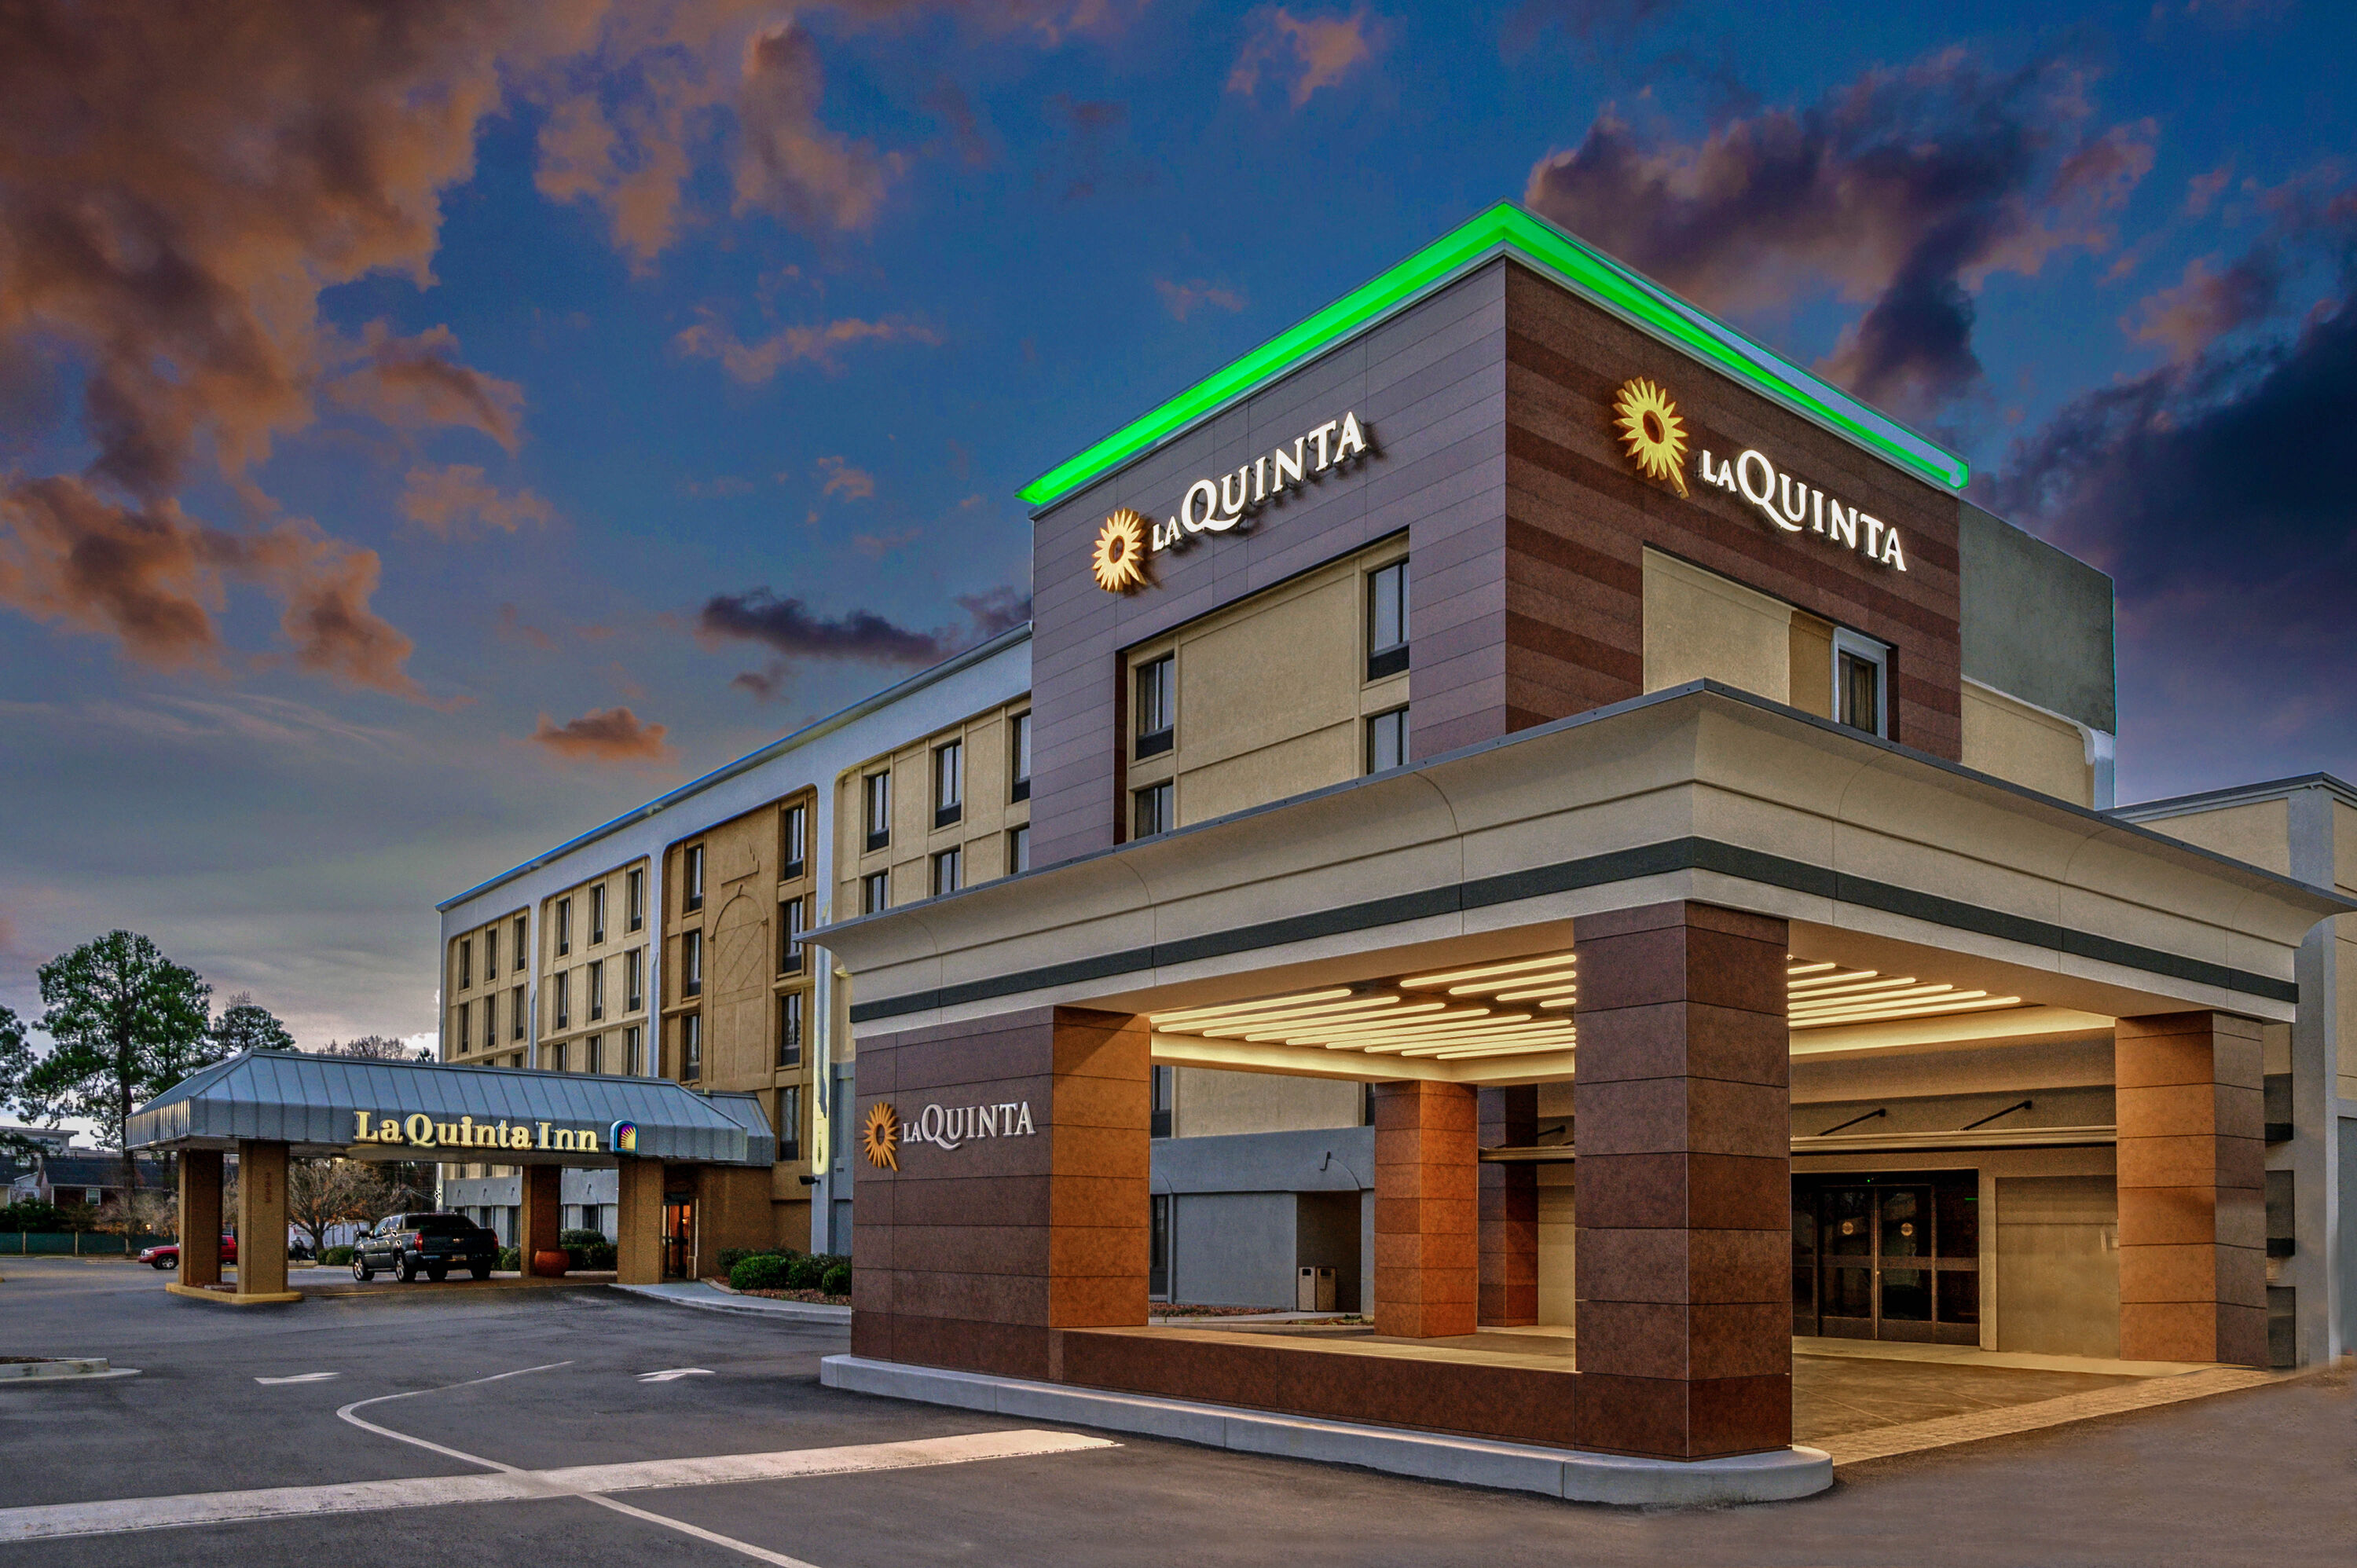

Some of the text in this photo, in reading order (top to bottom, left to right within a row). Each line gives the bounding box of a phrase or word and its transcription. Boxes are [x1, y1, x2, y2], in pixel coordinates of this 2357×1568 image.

[1152, 411, 1367, 551] LA QUINTA
[1701, 449, 1908, 572] LA QUINTA
[354, 1110, 599, 1153] La Quinta Inn
[903, 1101, 1036, 1151] LA QUINTA
